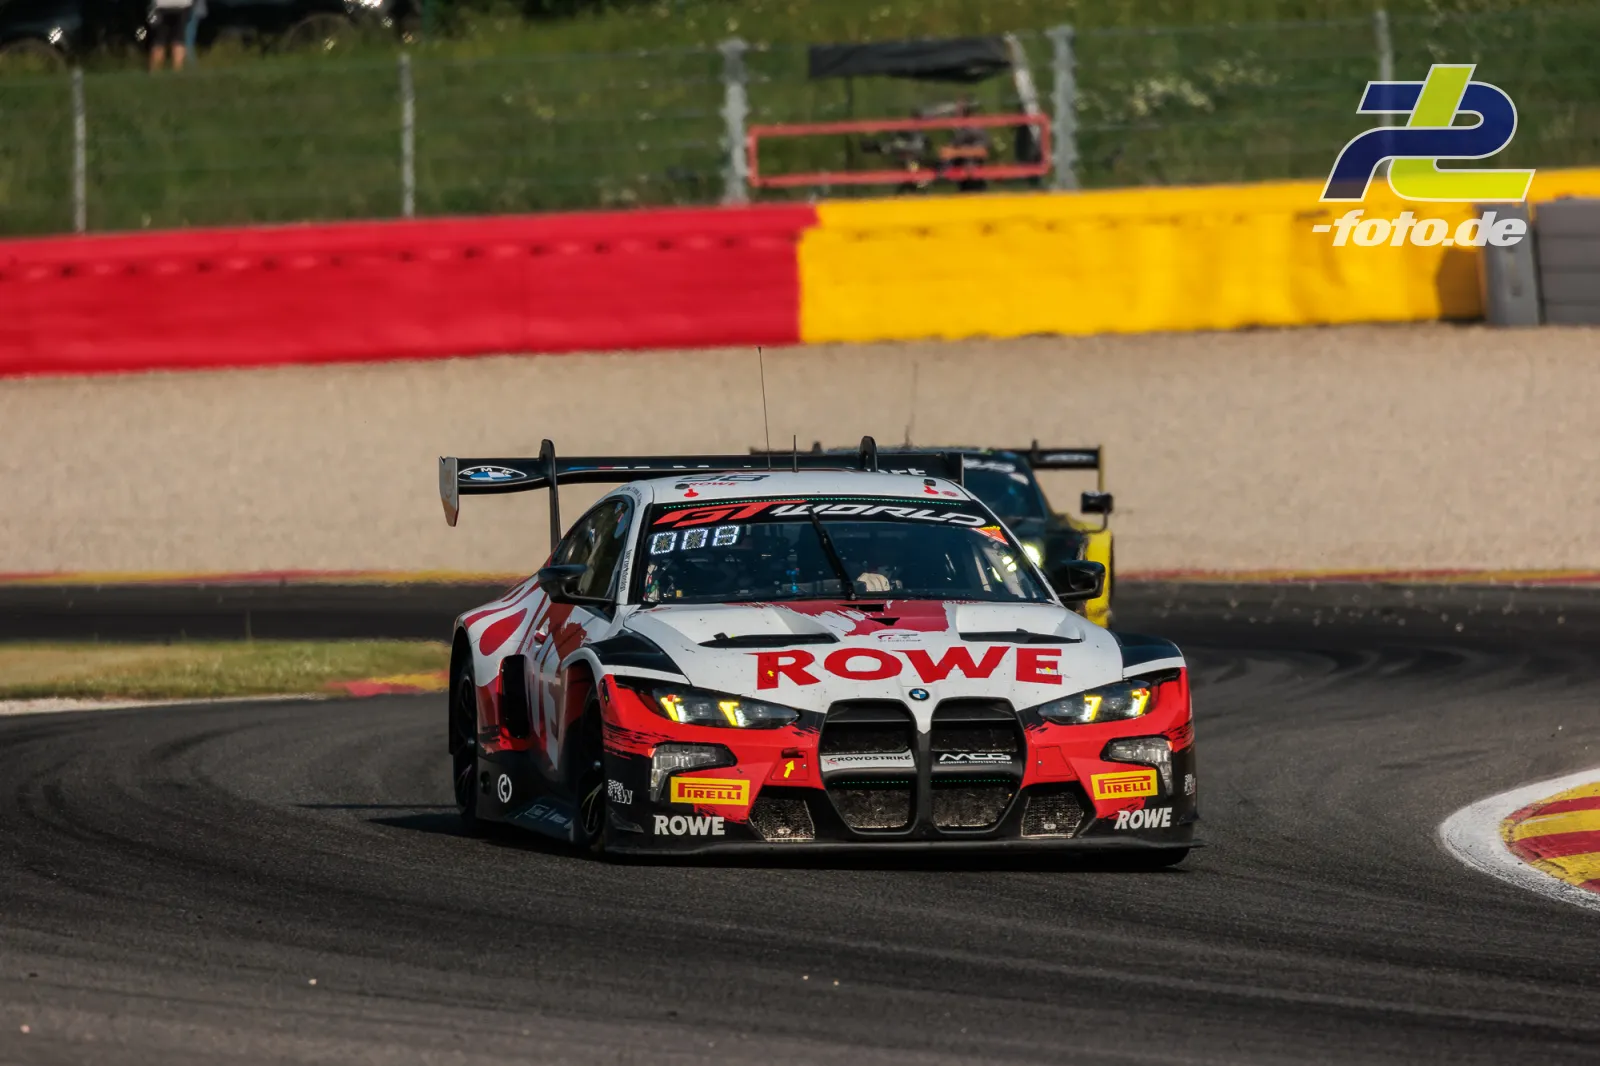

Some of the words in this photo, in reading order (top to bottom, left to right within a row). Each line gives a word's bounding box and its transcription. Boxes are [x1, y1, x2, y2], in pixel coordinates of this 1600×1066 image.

[653, 500, 807, 528] GT
[769, 503, 986, 528] WORLD
[745, 646, 1063, 690] ROWE
[677, 783, 743, 800] PIRELLI
[1098, 775, 1151, 795] PIRELLI
[653, 814, 725, 836] ROWE
[1113, 807, 1173, 830] ROWE
